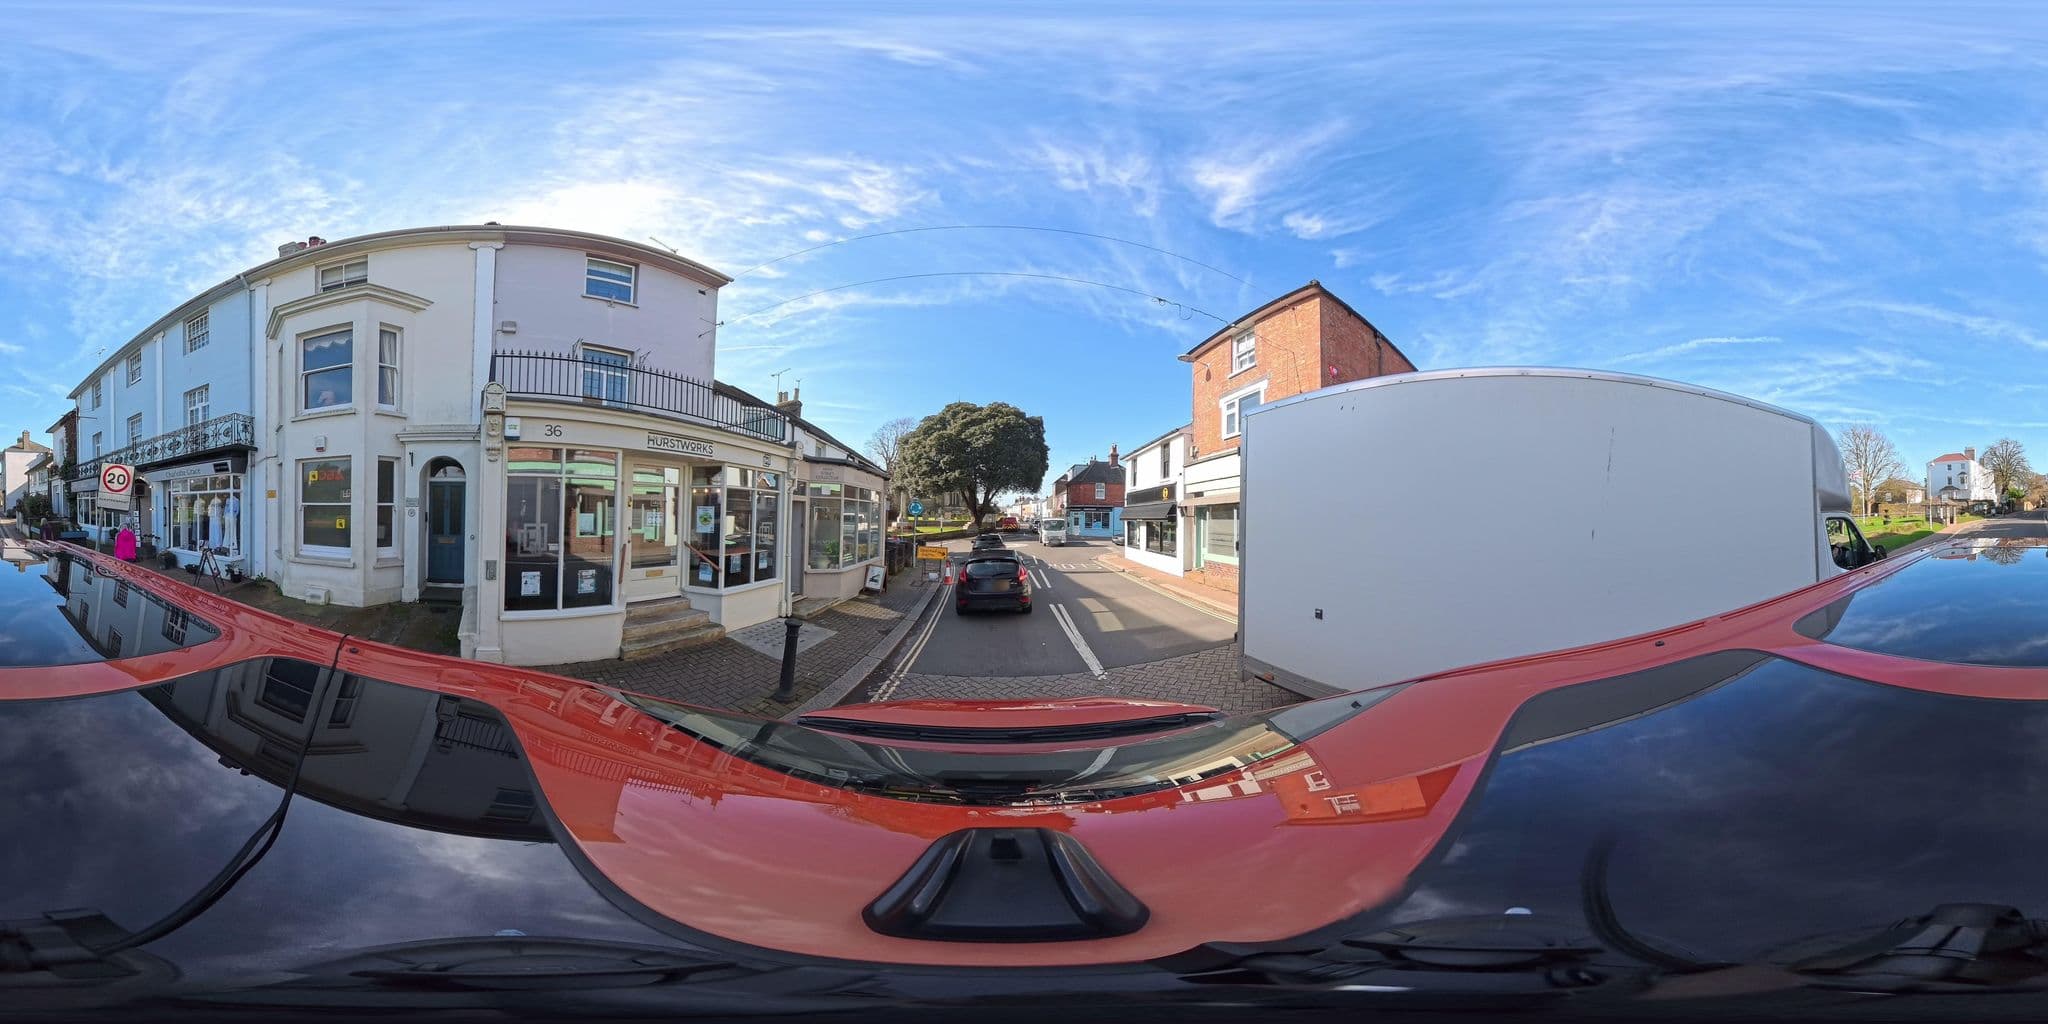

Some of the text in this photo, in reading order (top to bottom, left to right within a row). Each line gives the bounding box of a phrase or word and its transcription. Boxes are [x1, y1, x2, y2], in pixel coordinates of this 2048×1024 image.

[545, 424, 562, 437] 36
[647, 435, 714, 455] HURSTWORKS
[107, 472, 126, 485] 20
